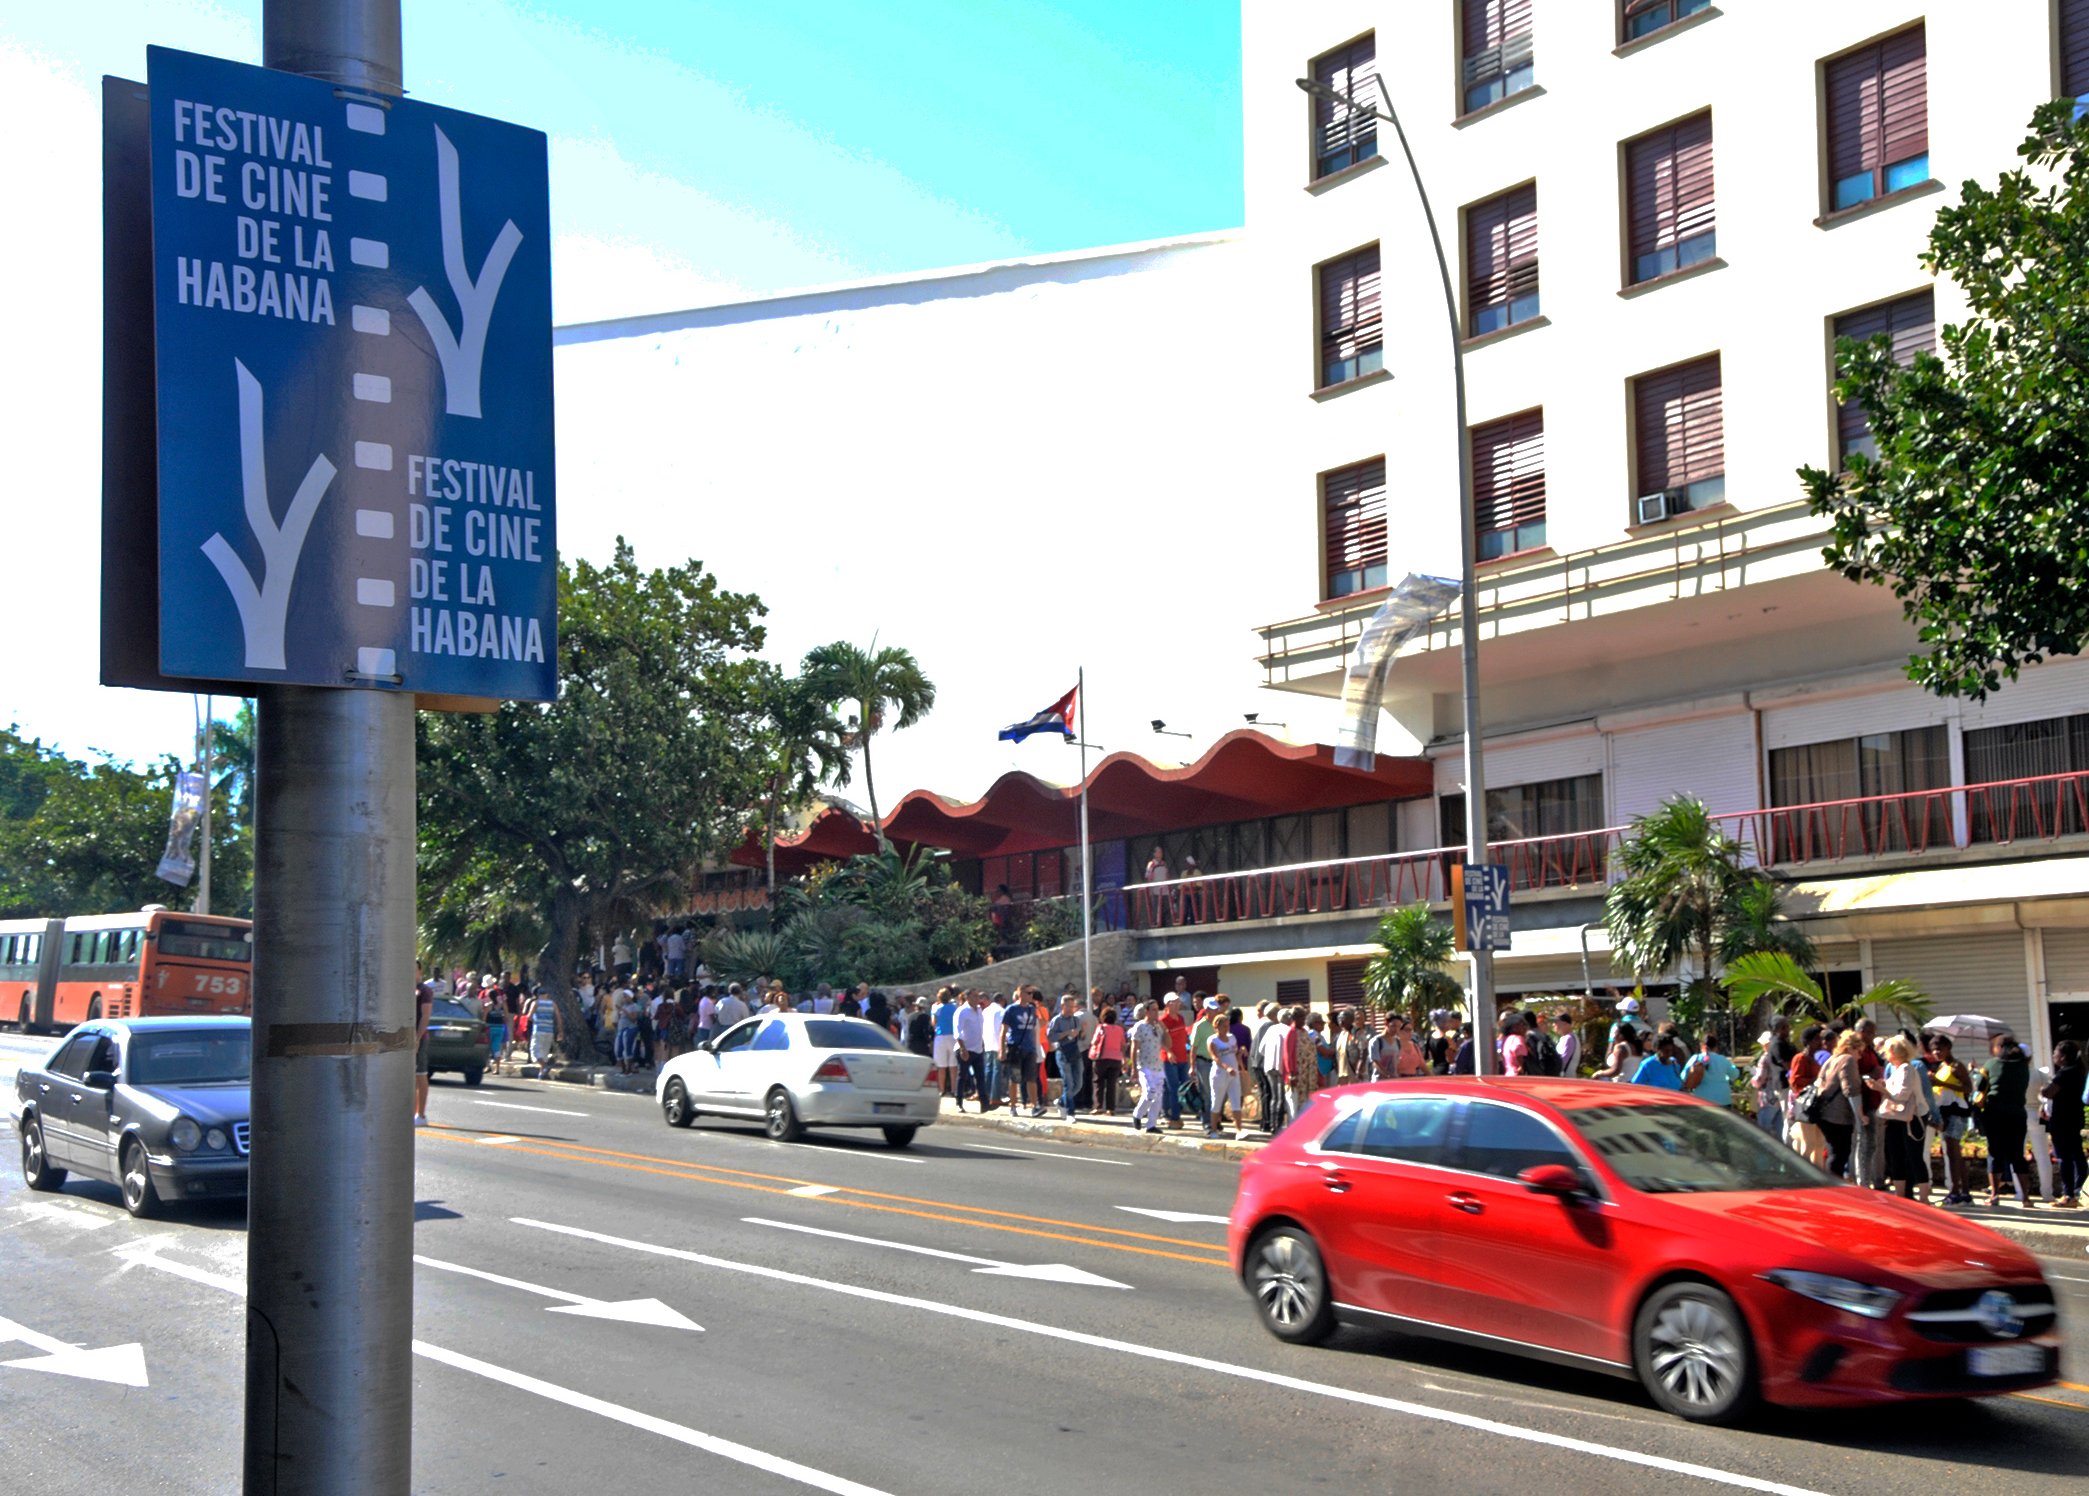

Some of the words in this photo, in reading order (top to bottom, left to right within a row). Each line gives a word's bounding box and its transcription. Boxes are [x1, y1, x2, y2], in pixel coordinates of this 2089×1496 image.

[174, 99, 332, 169] FESTIVAL
[175, 149, 227, 204] DE
[241, 161, 333, 222] CINE
[237, 215, 281, 264] DE
[294, 225, 335, 272] LA
[177, 256, 336, 326] HABANA
[408, 454, 541, 511] FESTIVAL
[409, 503, 453, 552] DE
[465, 509, 542, 563] CINE
[409, 557, 449, 602] DE
[460, 563, 496, 606] LA
[411, 606, 545, 664] HABANA
[195, 974, 240, 995] 753
